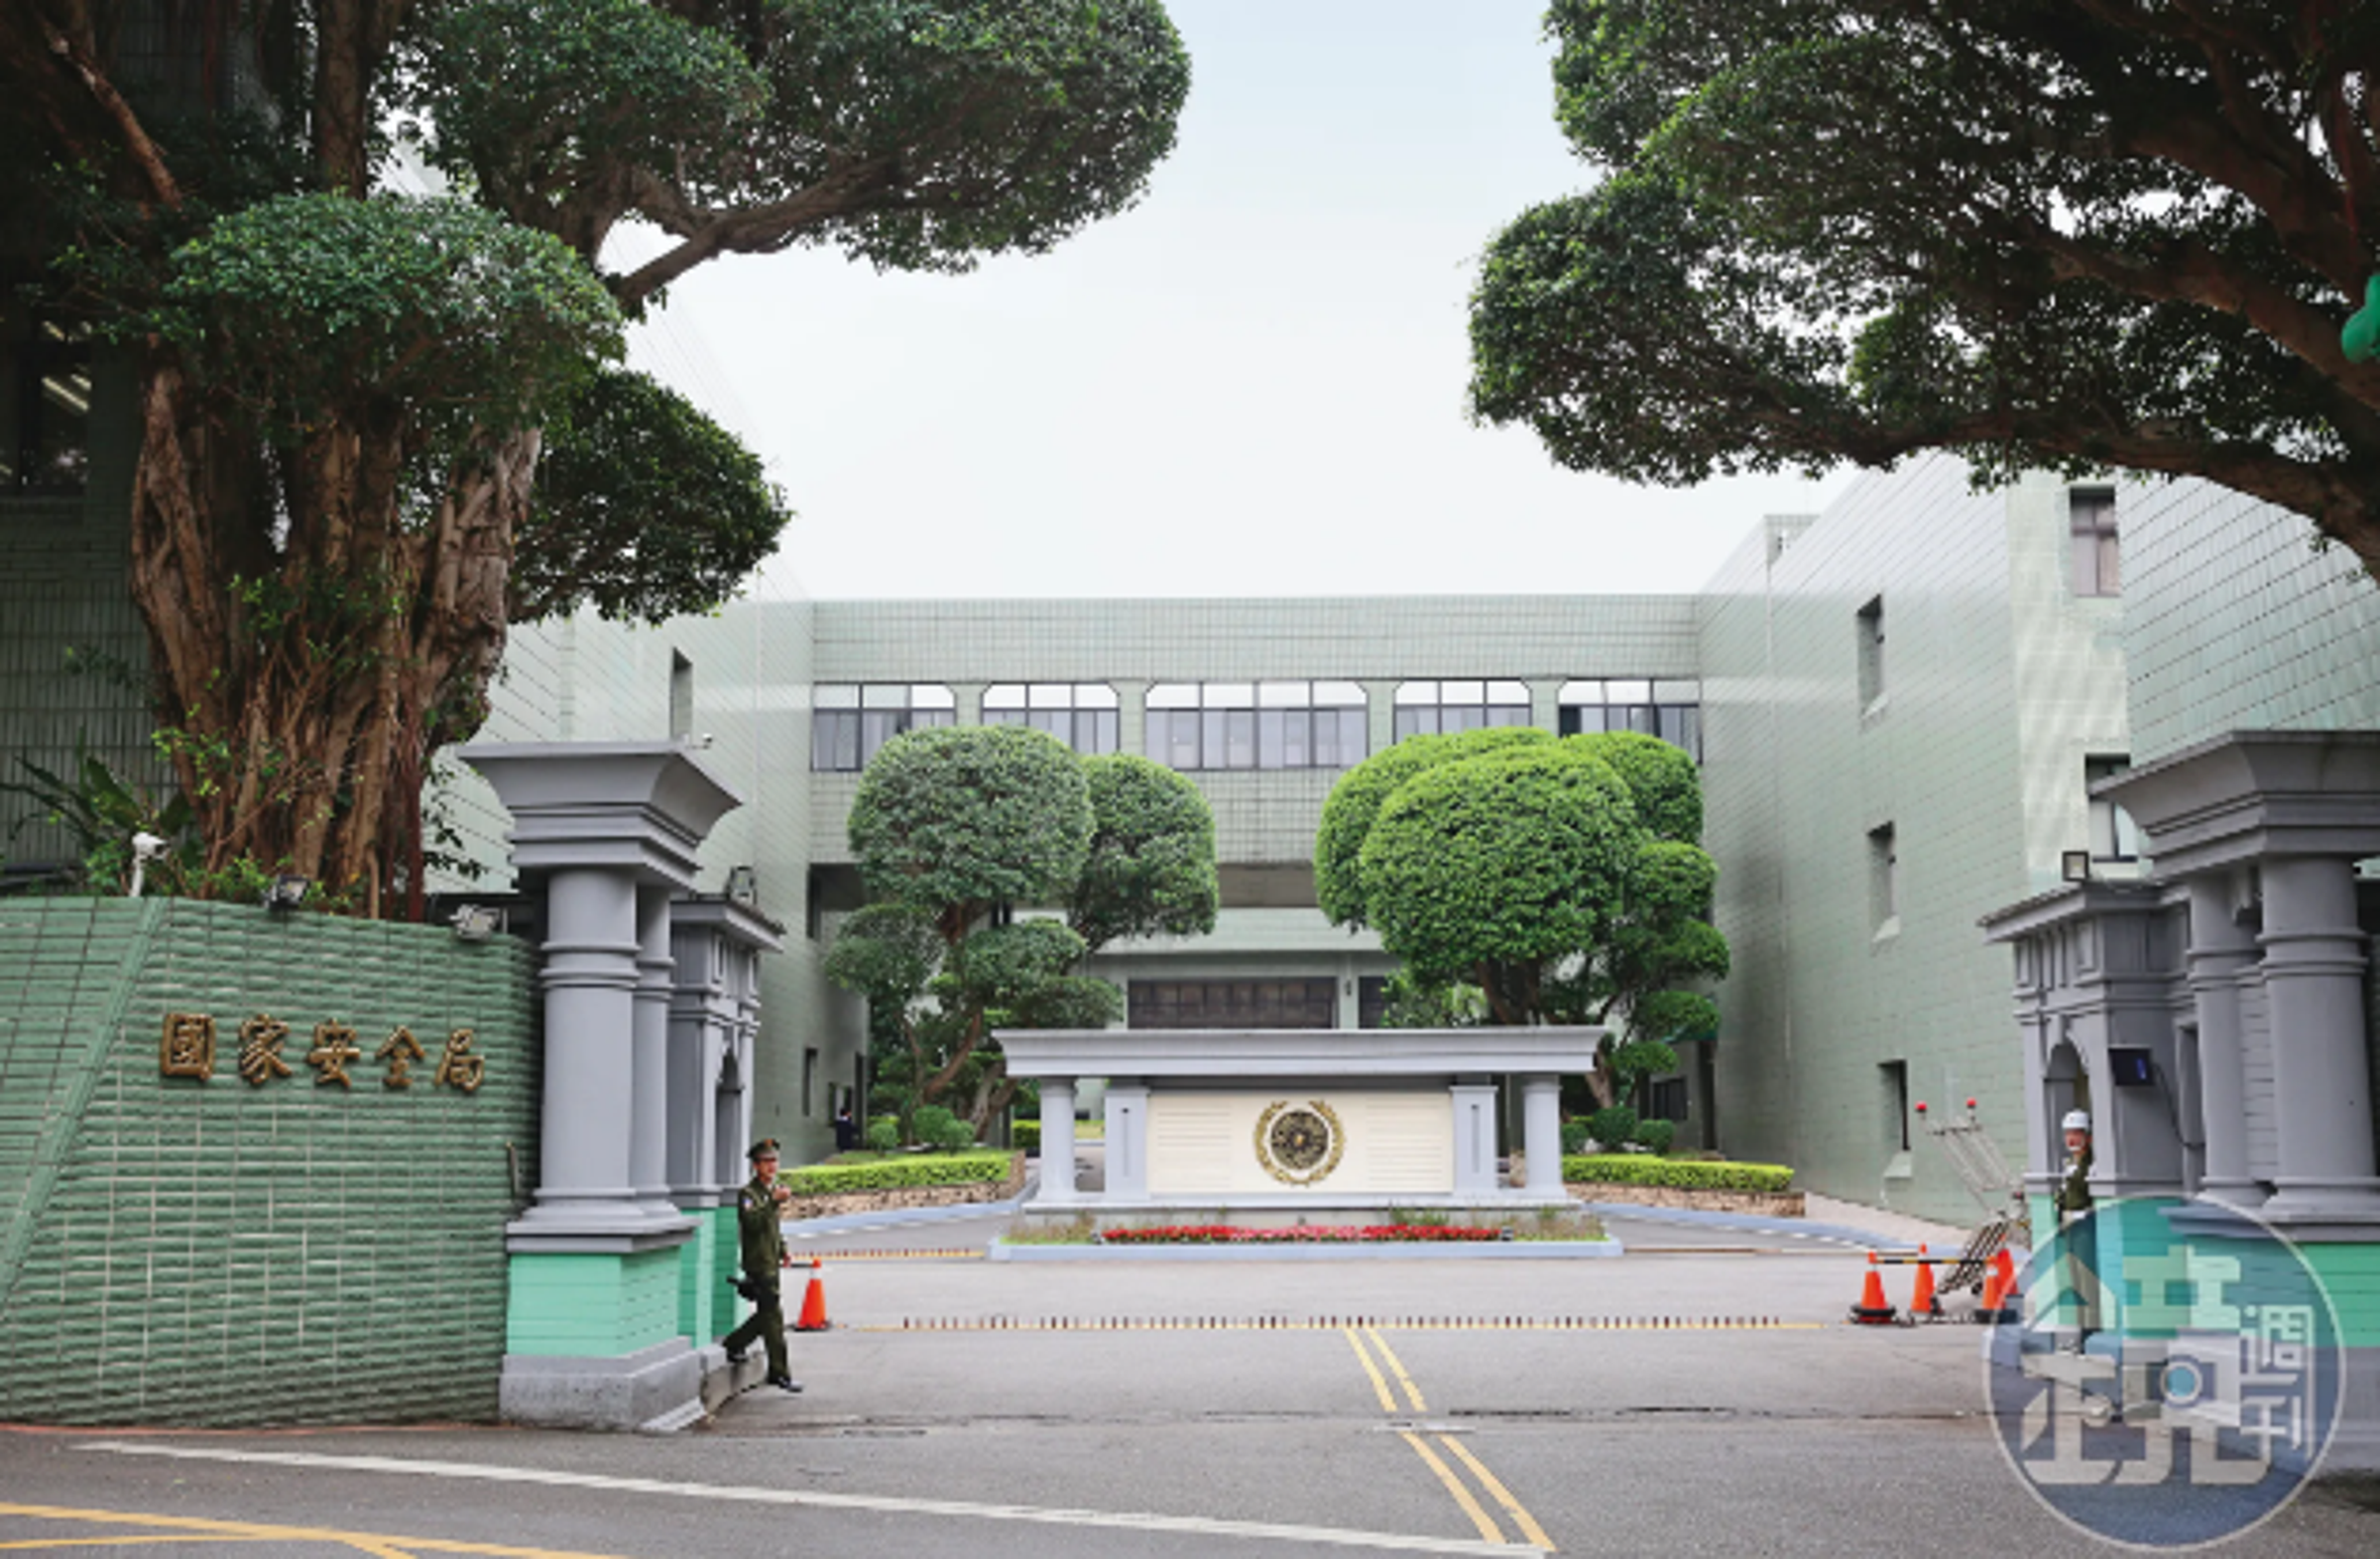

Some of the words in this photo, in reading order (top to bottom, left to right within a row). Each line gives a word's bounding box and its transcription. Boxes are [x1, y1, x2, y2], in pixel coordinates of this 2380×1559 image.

[160, 1013, 486, 1091] 國家安全局
